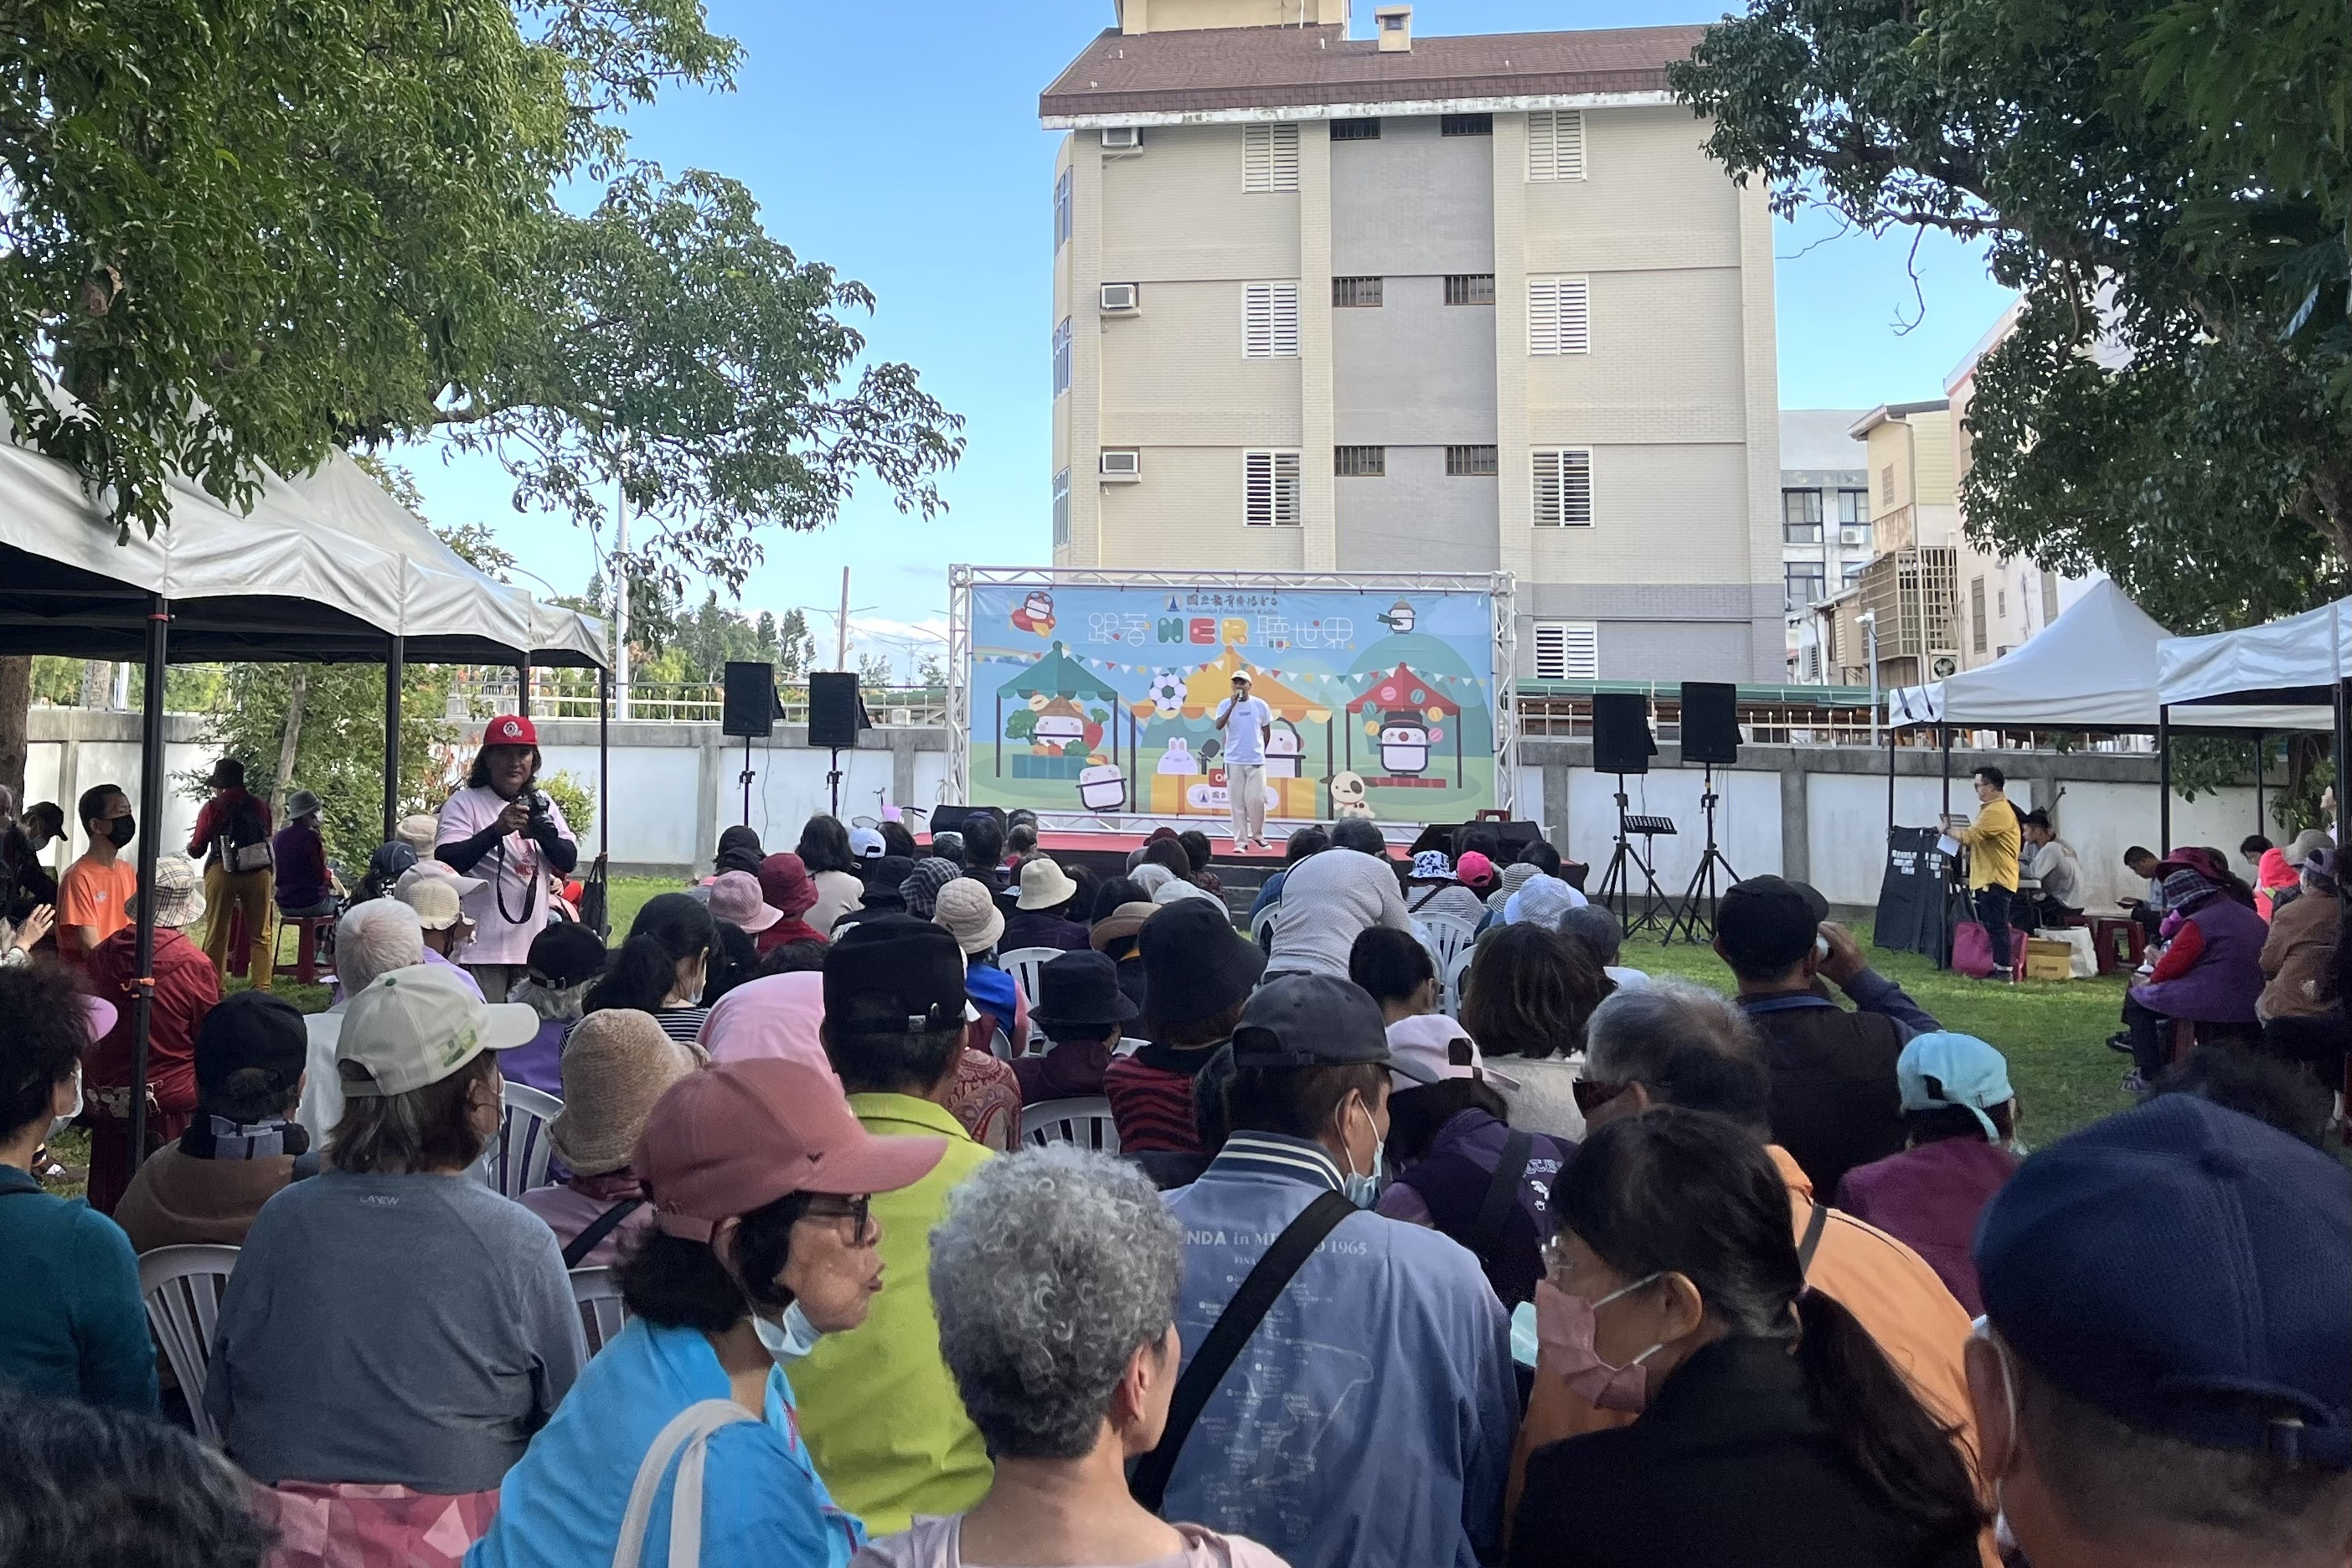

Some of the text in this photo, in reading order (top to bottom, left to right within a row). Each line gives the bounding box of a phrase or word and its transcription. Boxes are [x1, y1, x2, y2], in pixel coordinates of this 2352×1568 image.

[1186, 1231, 1227, 1246] NDA
[1331, 1240, 1367, 1256] 1965
[1235, 1256, 1256, 1265] FINA
